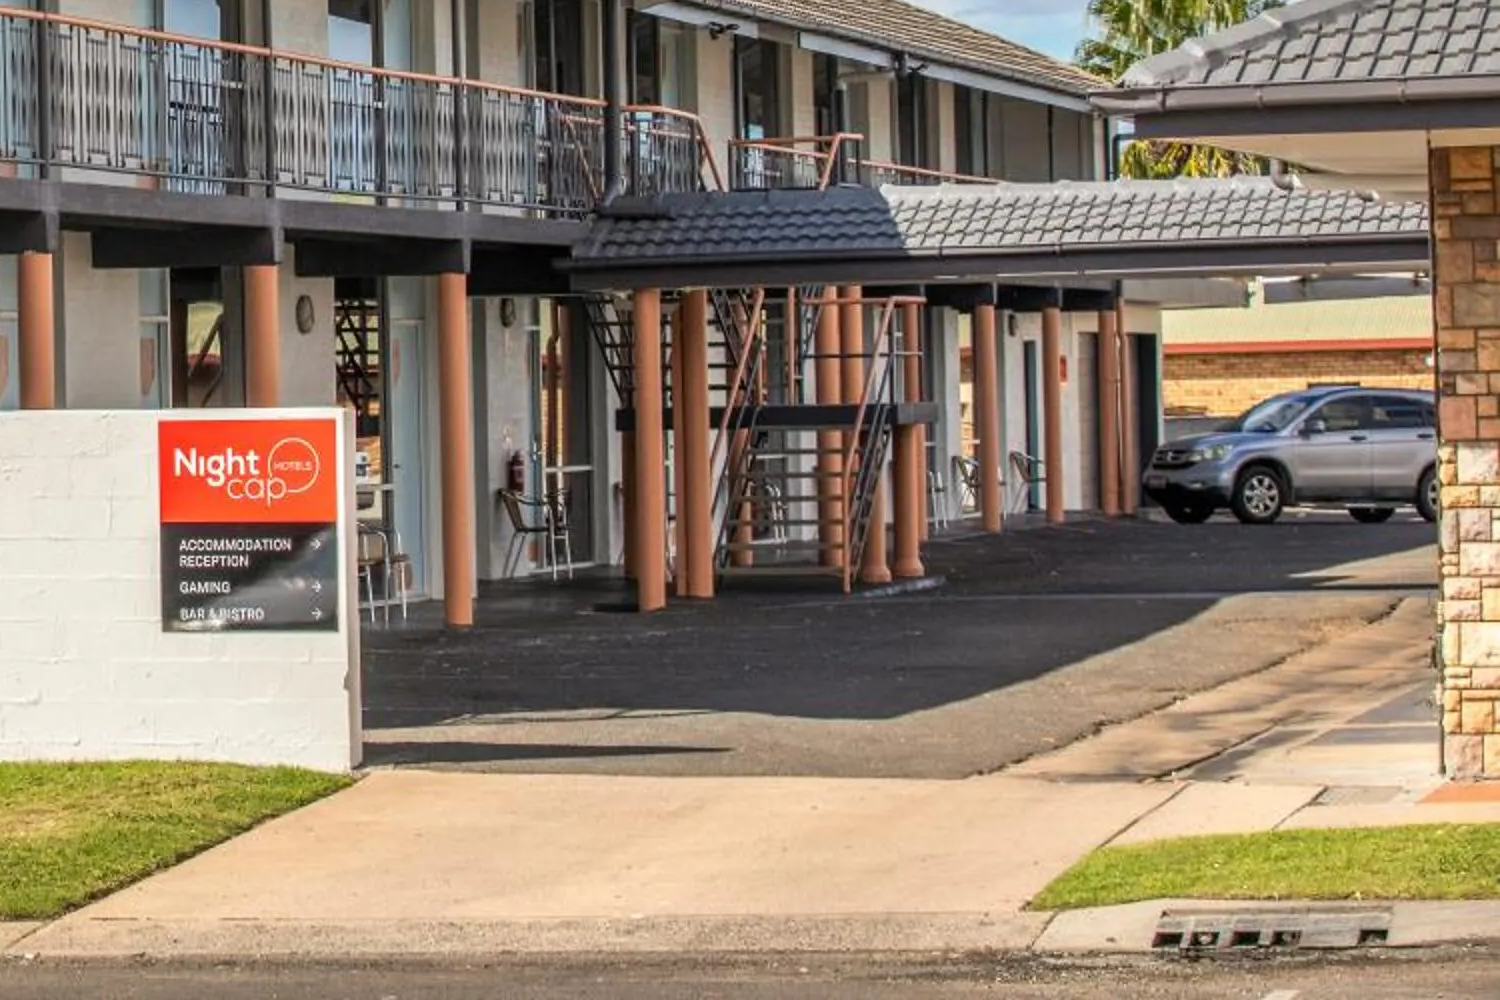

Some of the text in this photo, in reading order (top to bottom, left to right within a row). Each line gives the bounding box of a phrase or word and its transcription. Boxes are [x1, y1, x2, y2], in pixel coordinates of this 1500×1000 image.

[174, 447, 259, 487] Night
[274, 460, 313, 472] HOTELS
[227, 478, 286, 507] cap
[179, 537, 293, 552] ACCOMMODATION
[179, 554, 250, 568] RECEPTION
[179, 580, 232, 595] GAMING
[180, 607, 265, 621] BAR & BISTRO
